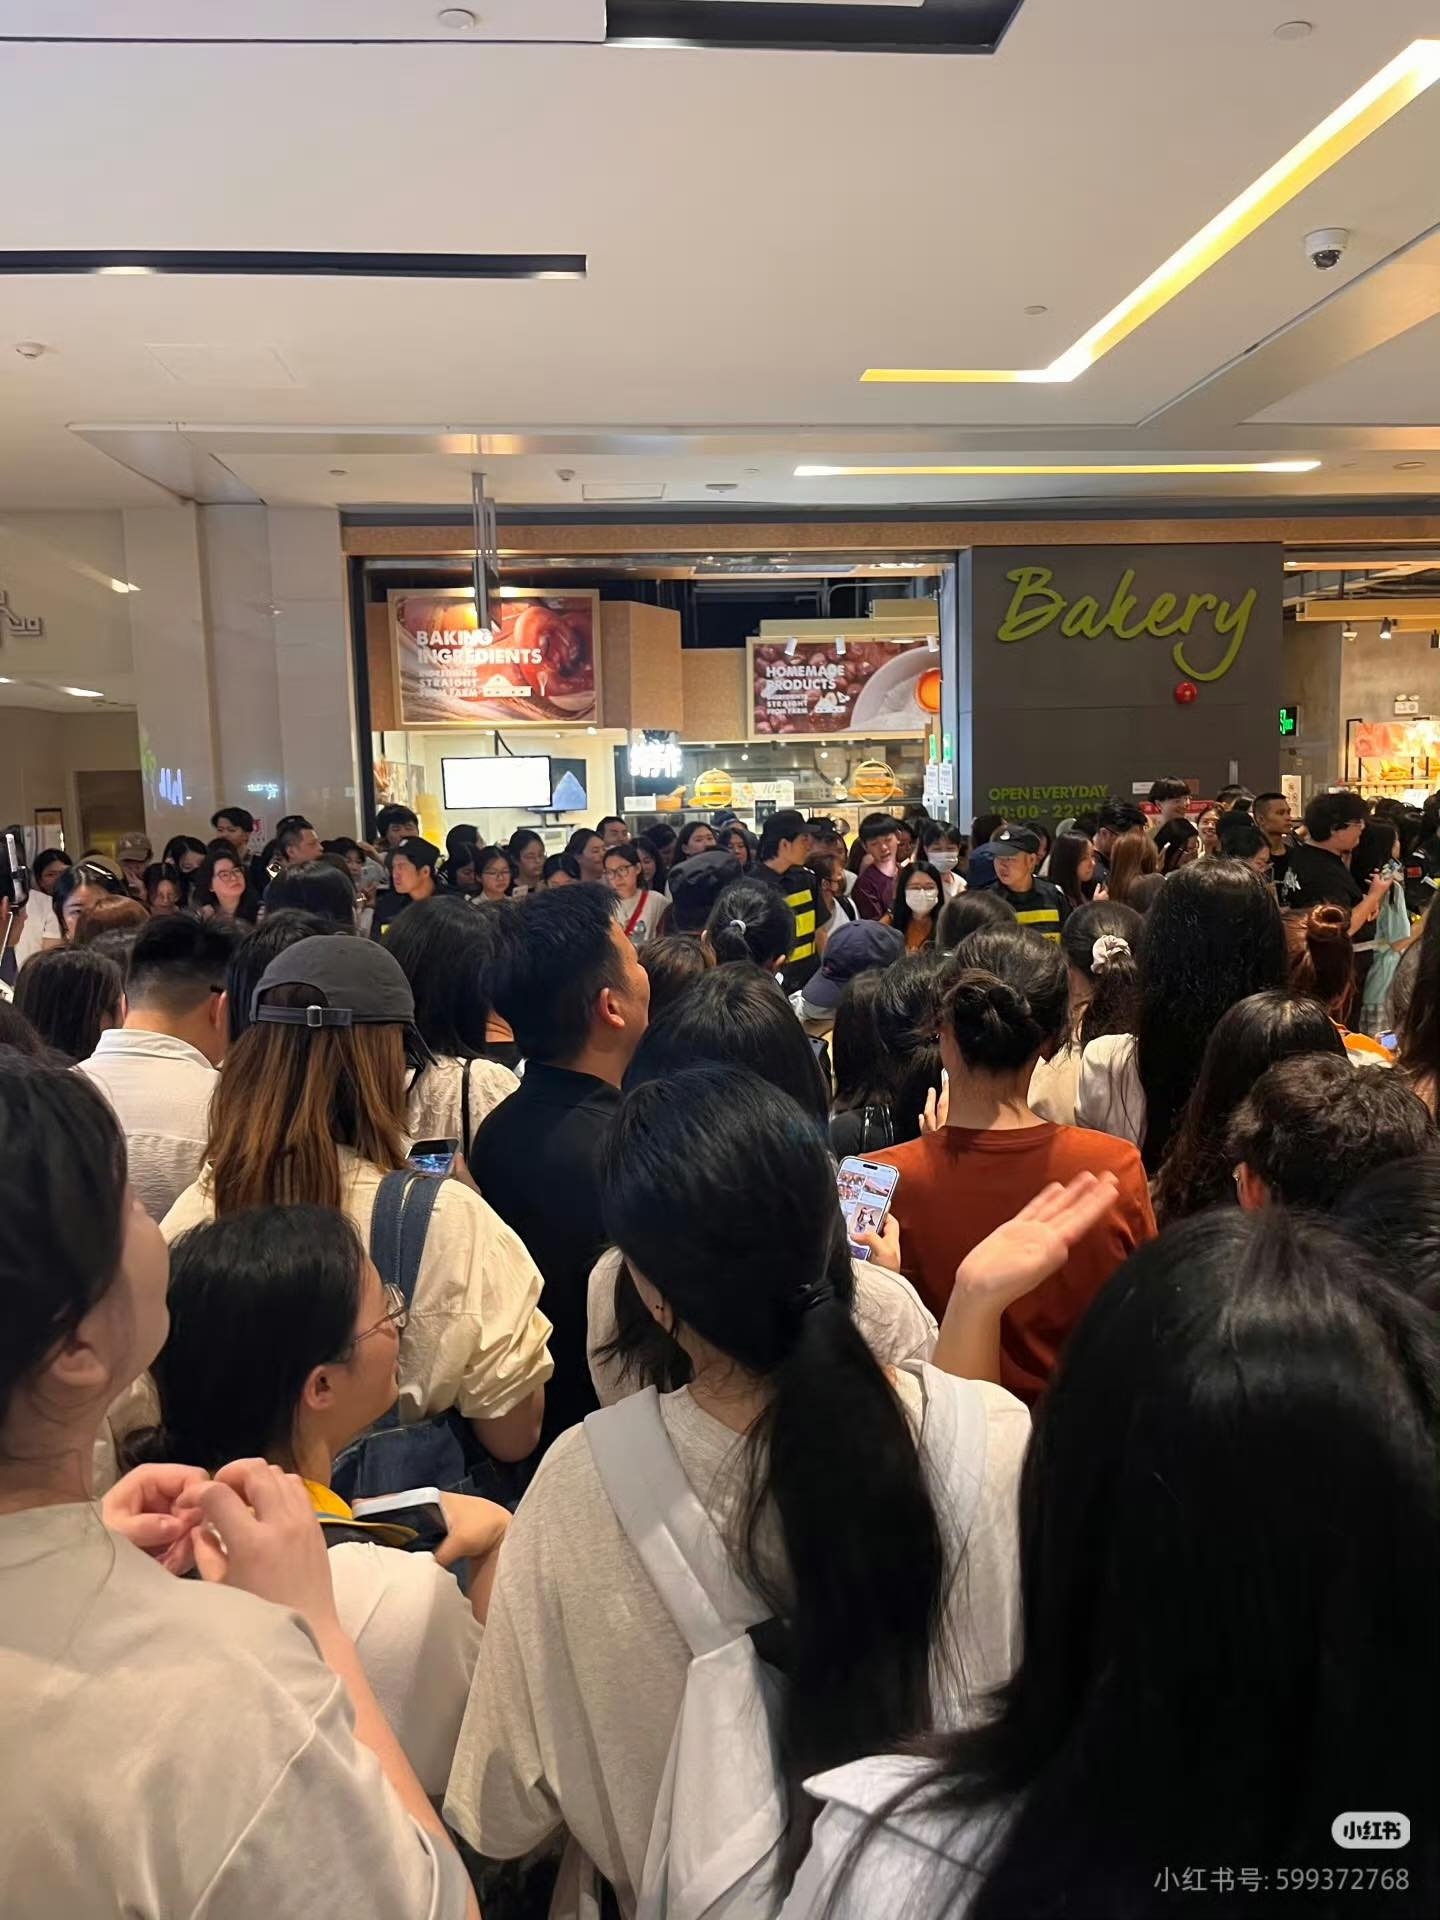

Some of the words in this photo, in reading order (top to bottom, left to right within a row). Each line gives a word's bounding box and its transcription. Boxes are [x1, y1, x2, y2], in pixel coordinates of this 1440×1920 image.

[997, 566, 1257, 681] Bakery
[416, 629, 493, 646] BAKING
[417, 648, 543, 664] INGREDIENTS
[765, 665, 845, 678] HOMEMADE
[766, 679, 837, 691] PRODUCTS
[988, 786, 1031, 801] OPEN
[1032, 784, 1108, 800] EVERYDAY
